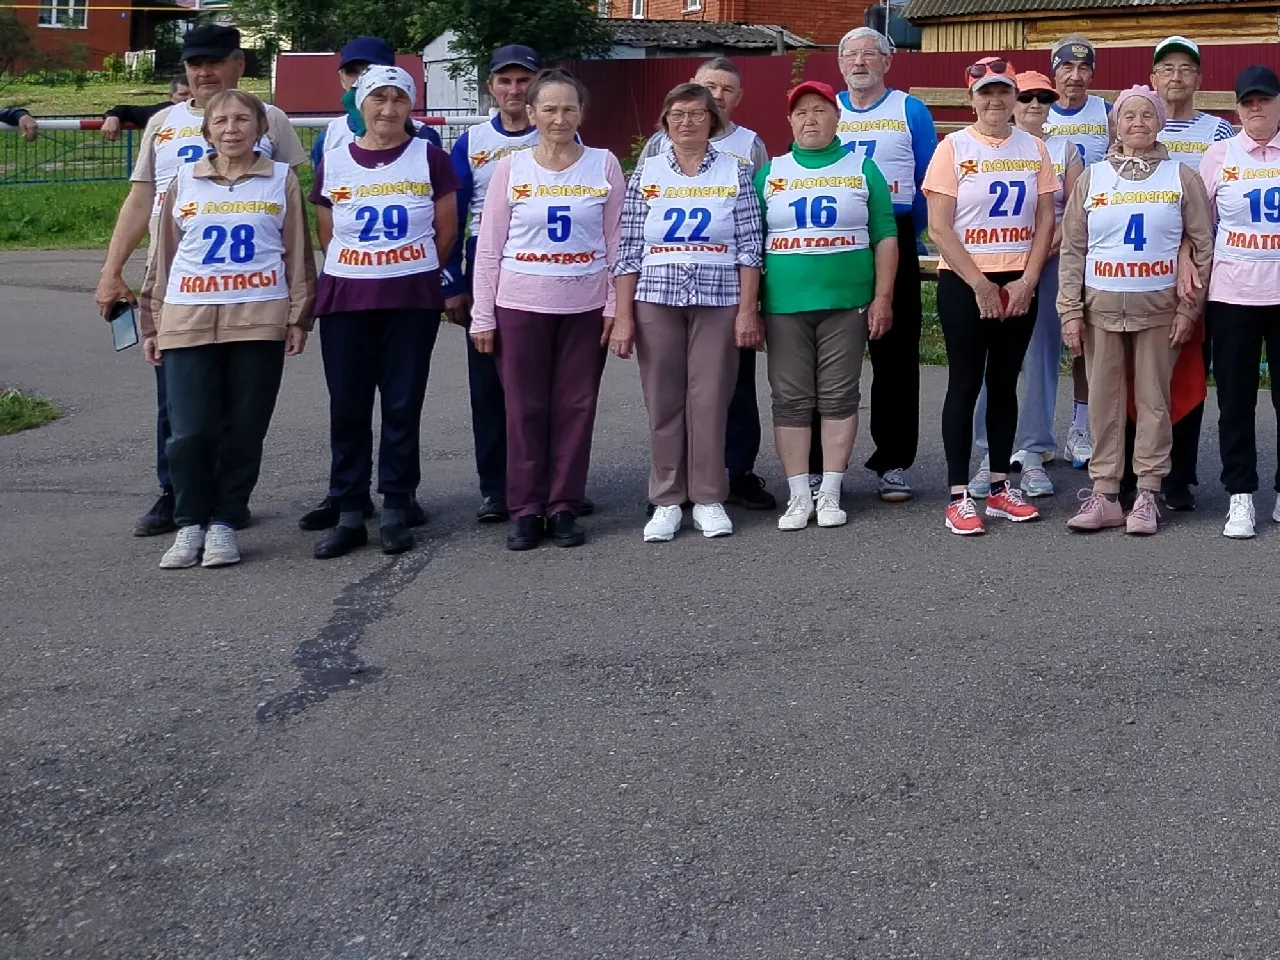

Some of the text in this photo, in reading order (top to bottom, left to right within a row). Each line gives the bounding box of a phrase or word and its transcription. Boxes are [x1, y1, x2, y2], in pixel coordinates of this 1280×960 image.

[1051, 124, 1106, 135] ДОВЕРИЕ
[982, 160, 1041, 172] ДОВЕРИЕ
[356, 181, 431, 198] ДОВЕРИЕ
[535, 184, 608, 198] ДОВЕРИЕ
[664, 185, 736, 198] ДОВЕРИЕ
[789, 176, 863, 189] ДОВЕРИЕ
[989, 181, 1027, 217] 27
[1111, 191, 1180, 204] ДОВЕРИЕ
[789, 195, 837, 228] 16
[355, 205, 408, 242] 29
[547, 206, 571, 242] 5
[663, 208, 711, 243] 22
[1124, 214, 1147, 251] 4
[202, 224, 255, 264] 28
[770, 236, 856, 249] КАЛТАСЫ
[338, 243, 427, 265] КАЛТАСЫ
[1095, 260, 1173, 277] КАЛТАСЫ
[180, 271, 277, 293] КАЛТАСЫ
